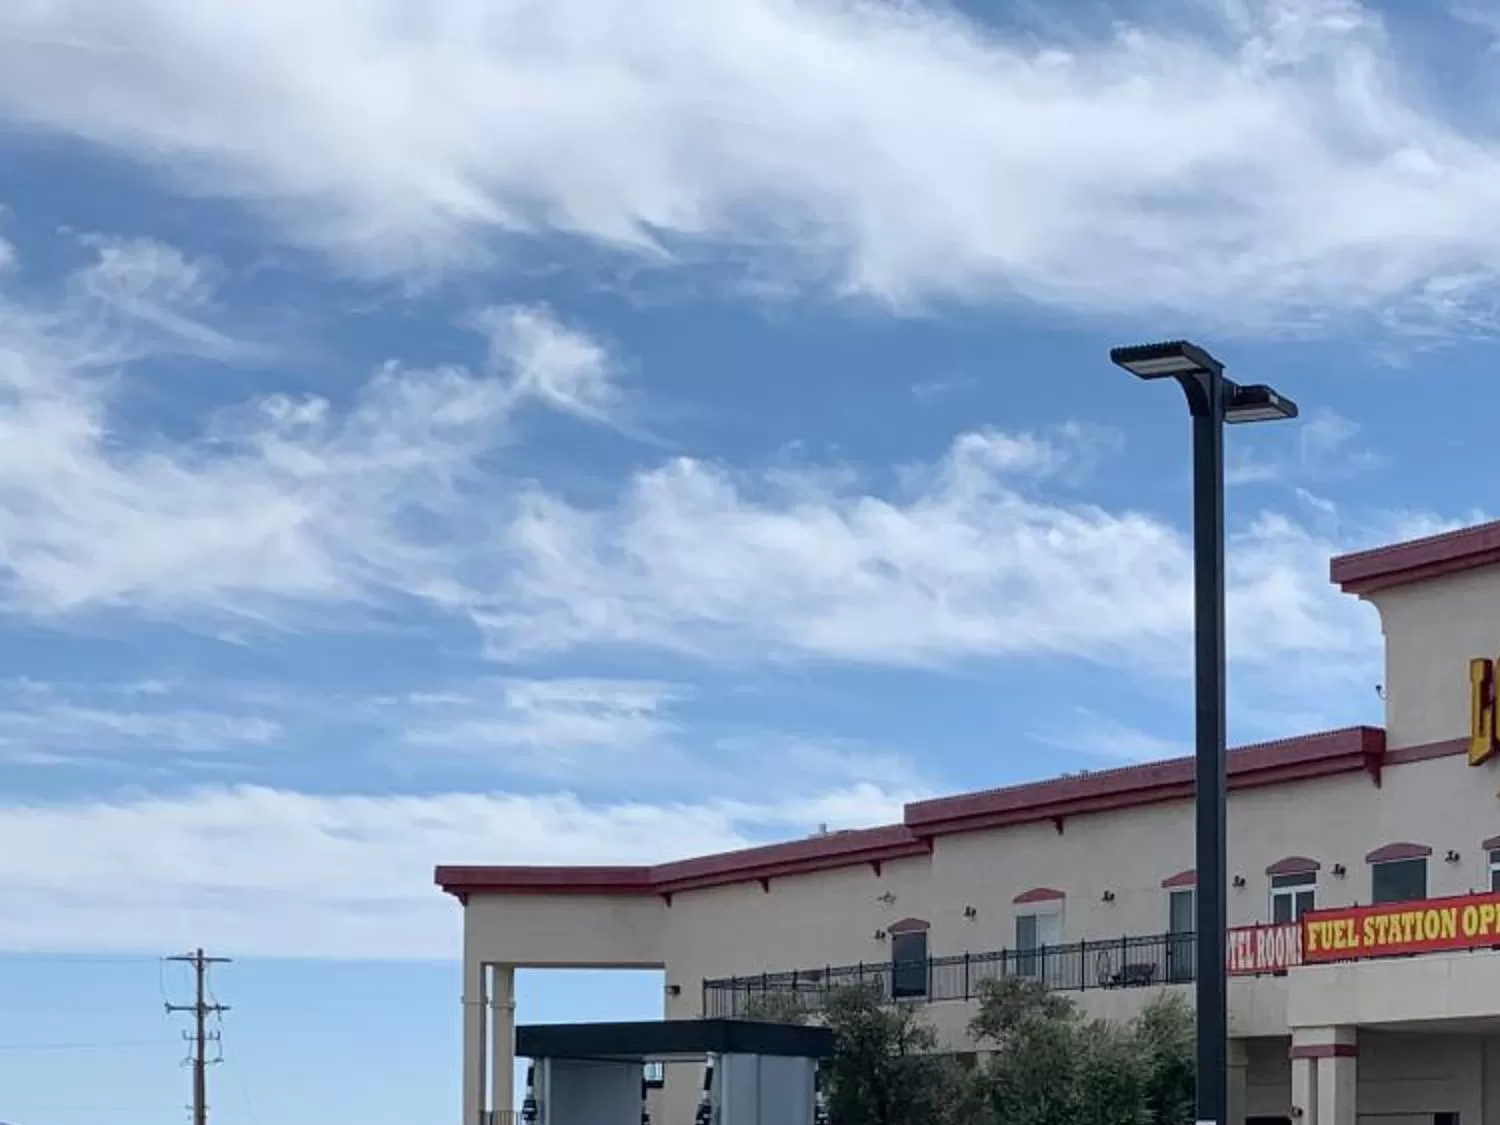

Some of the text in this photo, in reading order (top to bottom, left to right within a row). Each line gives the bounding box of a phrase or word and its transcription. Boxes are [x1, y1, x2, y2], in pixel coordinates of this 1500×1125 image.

[1226, 928, 1255, 970] TEL
[1307, 919, 1359, 951] FUEL
[1362, 908, 1457, 946] STATION
